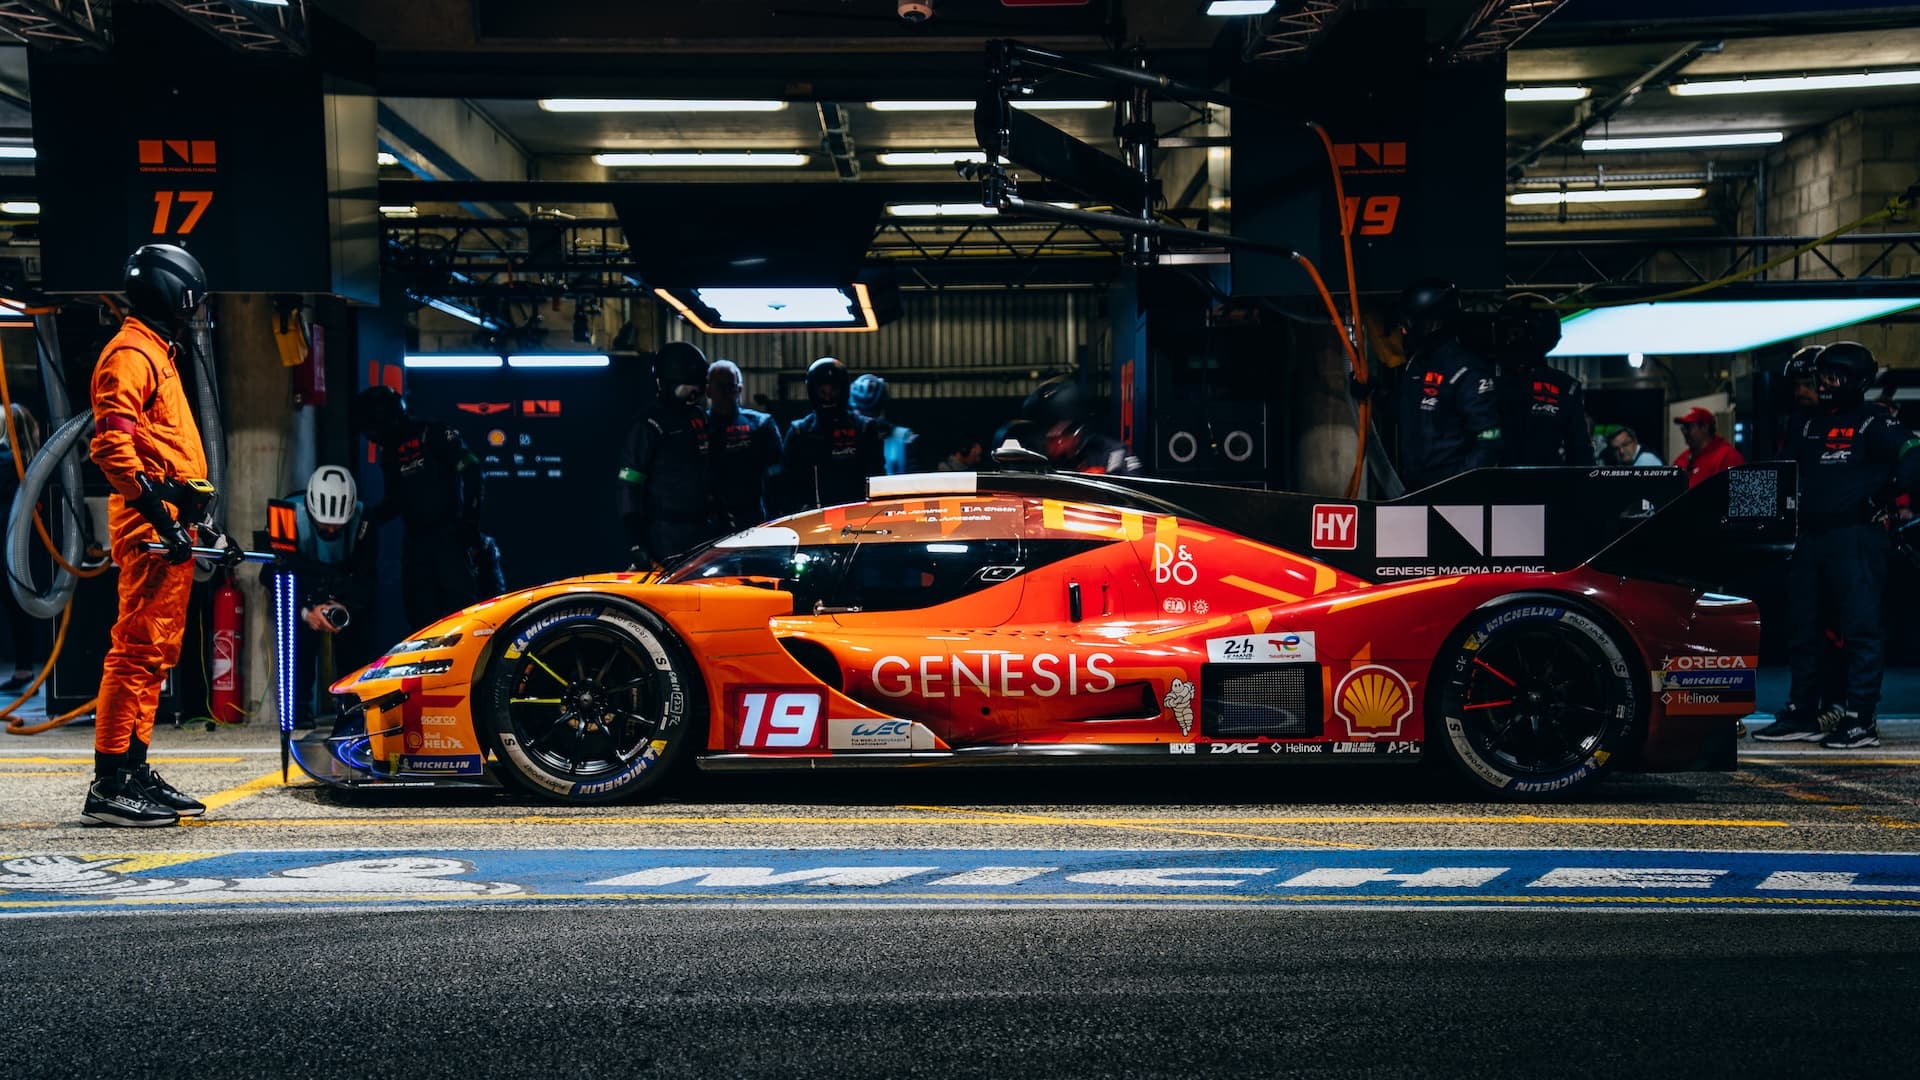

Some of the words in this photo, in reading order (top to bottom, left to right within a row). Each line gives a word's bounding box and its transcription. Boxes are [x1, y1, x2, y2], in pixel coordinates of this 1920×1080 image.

[152, 191, 214, 234] 17
[1316, 513, 1354, 541] HY
[1376, 566, 1436, 577] GENESIS
[1438, 565, 1490, 576] MAGMA
[1492, 565, 1545, 574] RACING
[1163, 599, 1187, 613] FIA
[525, 608, 595, 640] MICHELIN
[1486, 607, 1557, 633] MICHELIN
[655, 657, 667, 665] S
[1677, 656, 1747, 669] ORECA
[871, 653, 1116, 698] GENESIS
[1681, 676, 1744, 686] MICHELIN
[1678, 692, 1720, 704] Helinox
[421, 716, 456, 725] sparco
[739, 693, 821, 747] 19
[424, 736, 464, 749] HELIX
[1210, 743, 1260, 754] DAC
[1285, 743, 1322, 753] Helinox
[1387, 741, 1420, 754] APL
[412, 761, 470, 769] MICHELIN
[578, 760, 648, 795] MICHELIN
[1514, 767, 1587, 792] MICHELIN
